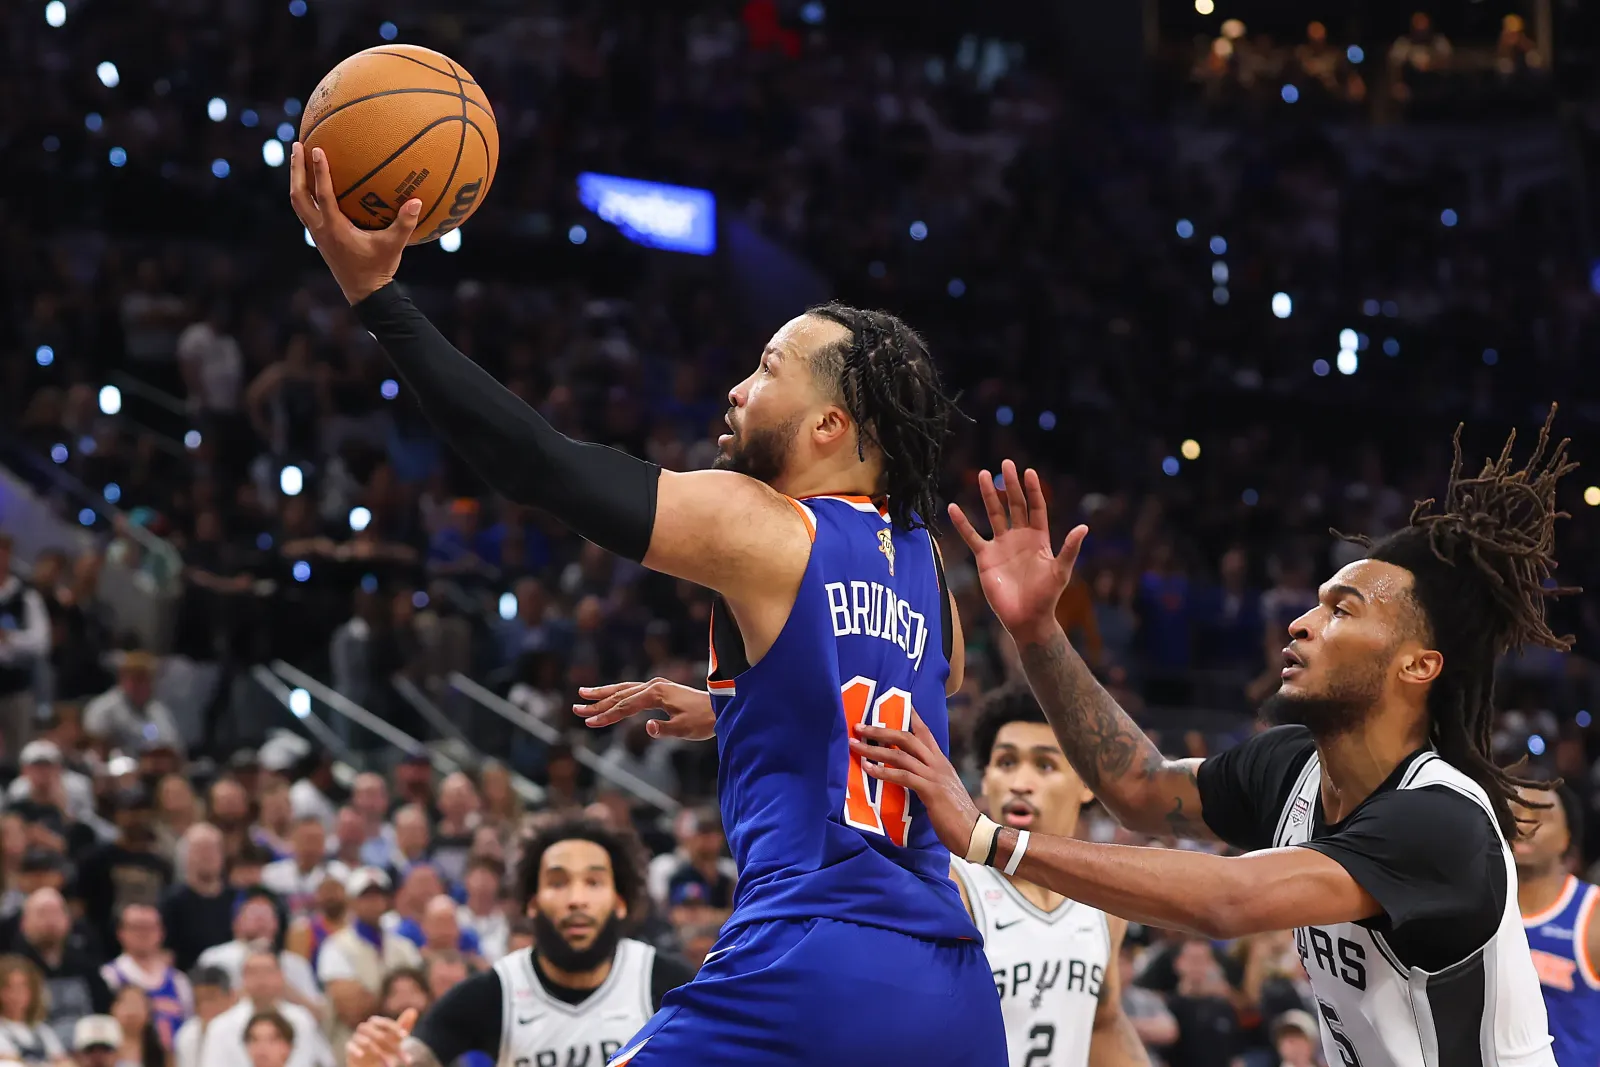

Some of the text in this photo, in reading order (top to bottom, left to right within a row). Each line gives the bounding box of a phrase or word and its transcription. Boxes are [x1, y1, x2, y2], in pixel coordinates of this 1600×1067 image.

[825, 580, 928, 672] BRUNSO
[841, 675, 912, 848] 11
[992, 958, 1104, 1009] SPURS
[1022, 1022, 1055, 1067] 2
